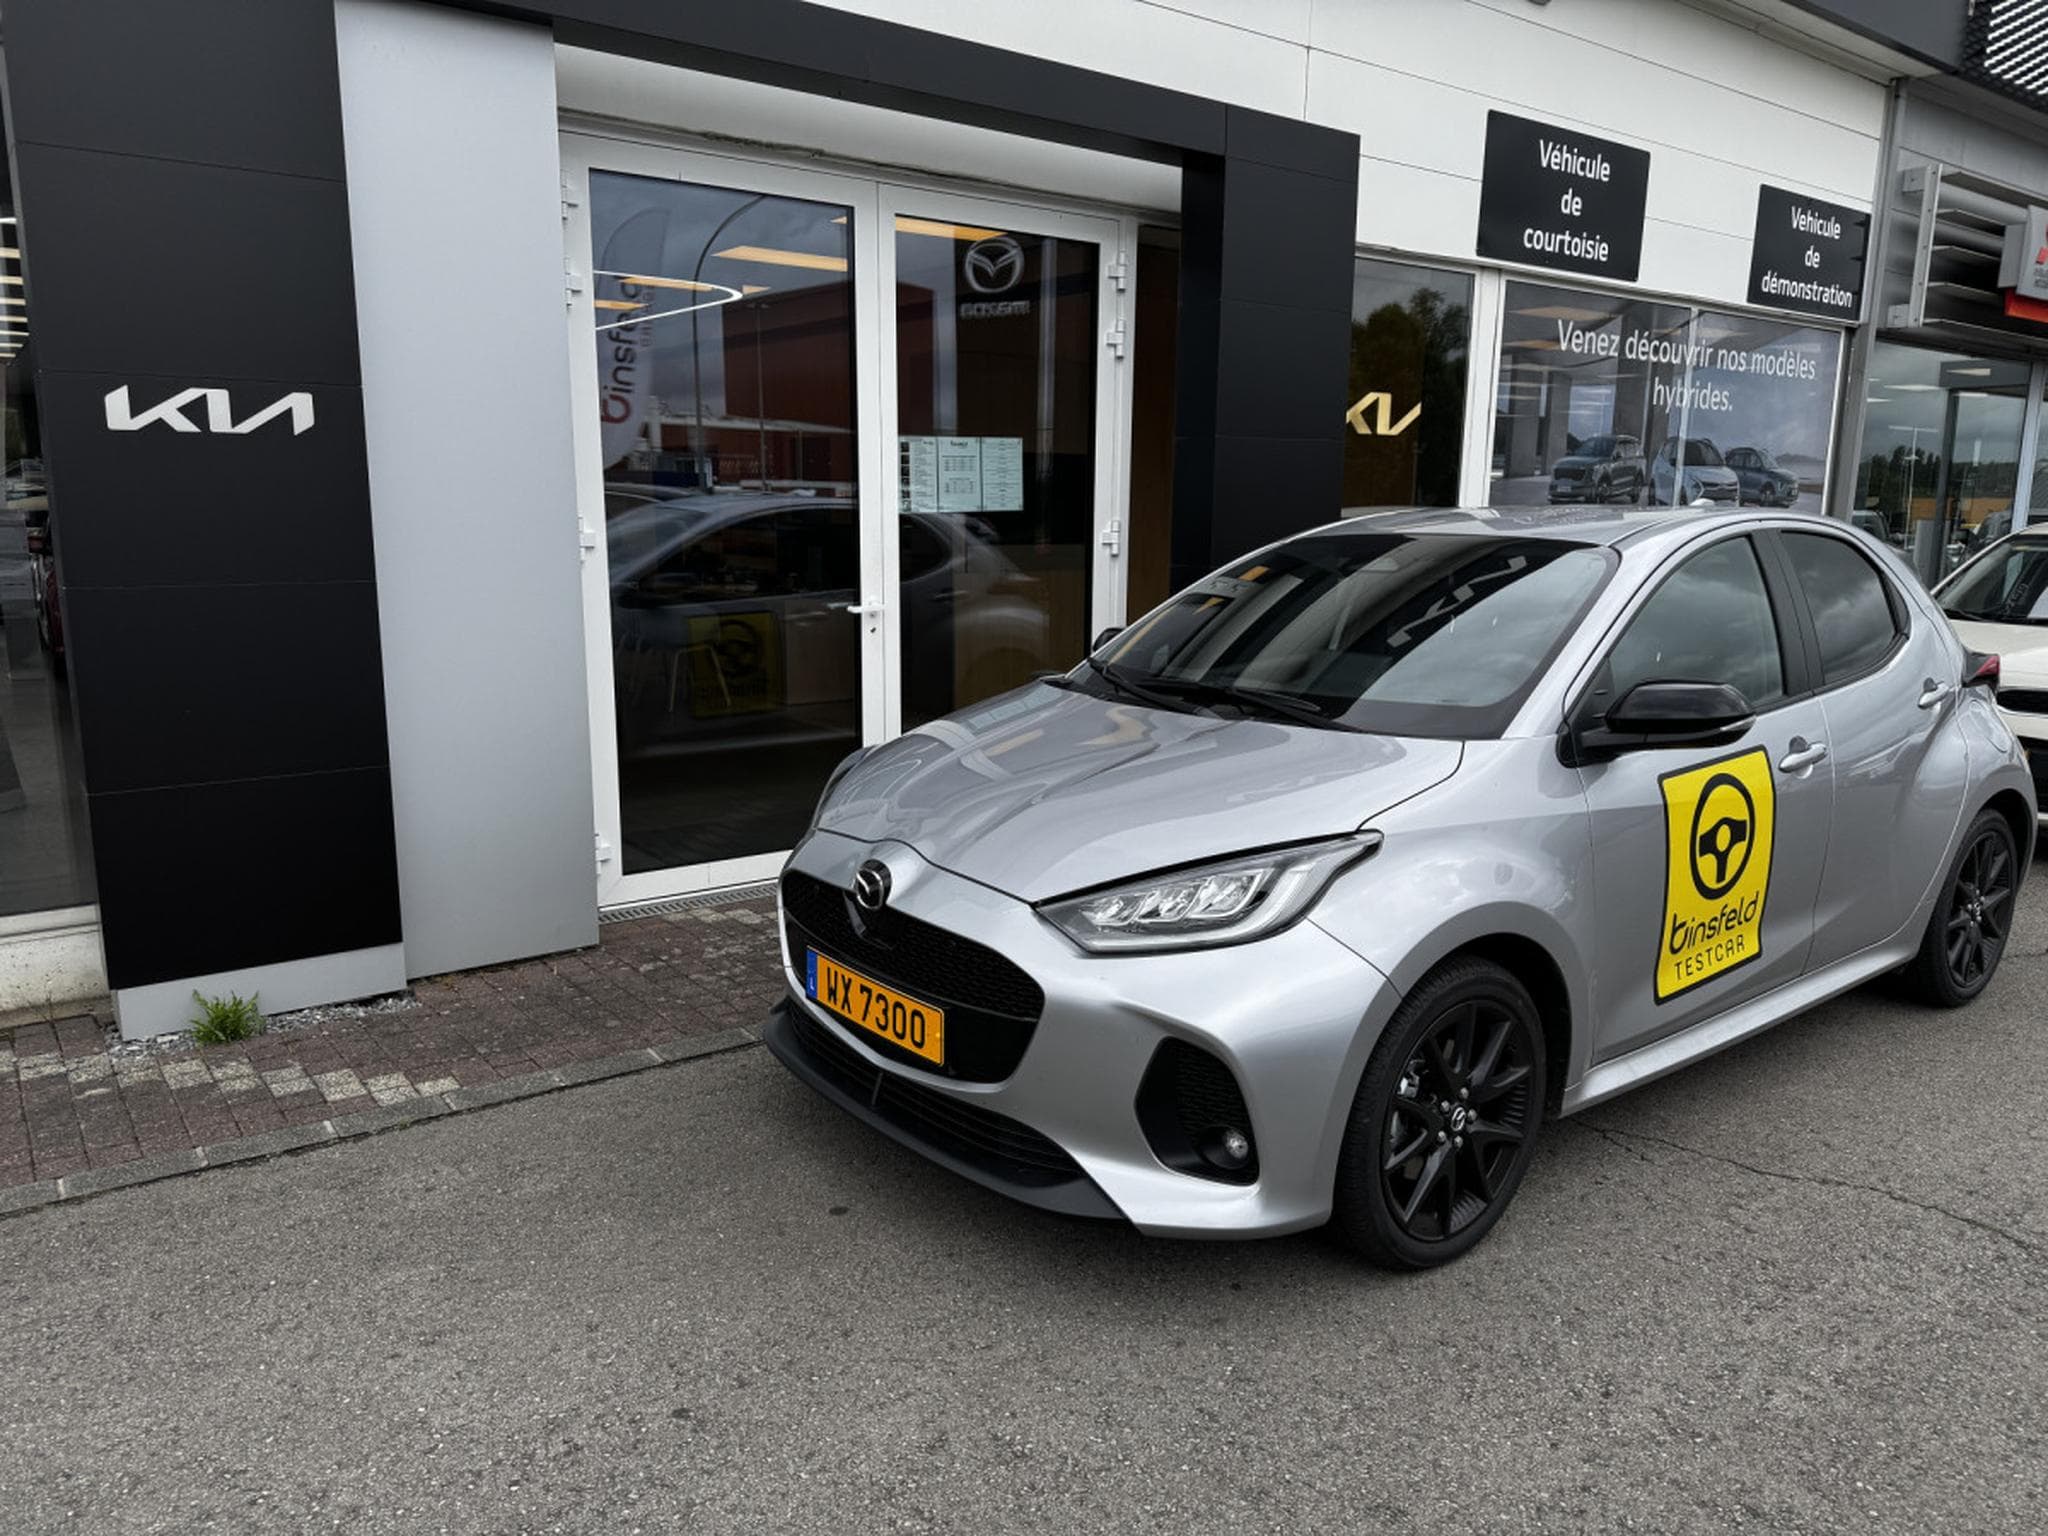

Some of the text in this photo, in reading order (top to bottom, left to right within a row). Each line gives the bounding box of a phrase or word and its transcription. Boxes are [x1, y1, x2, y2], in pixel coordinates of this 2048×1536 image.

[1539, 139, 1611, 182] Véhicule
[1560, 187, 1583, 216] de
[1523, 228, 1610, 262] courtoisie
[1804, 245, 1820, 268] de
[1761, 270, 1853, 308] démonstration
[1557, 319, 1816, 380] Venez découvrir nos modèles
[104, 384, 315, 436] KIA
[1652, 376, 1734, 414] hybrides.
[1669, 889, 1760, 955] binsfeld
[1674, 934, 1745, 980] TESTCAR
[826, 965, 926, 1050] WX 7300
